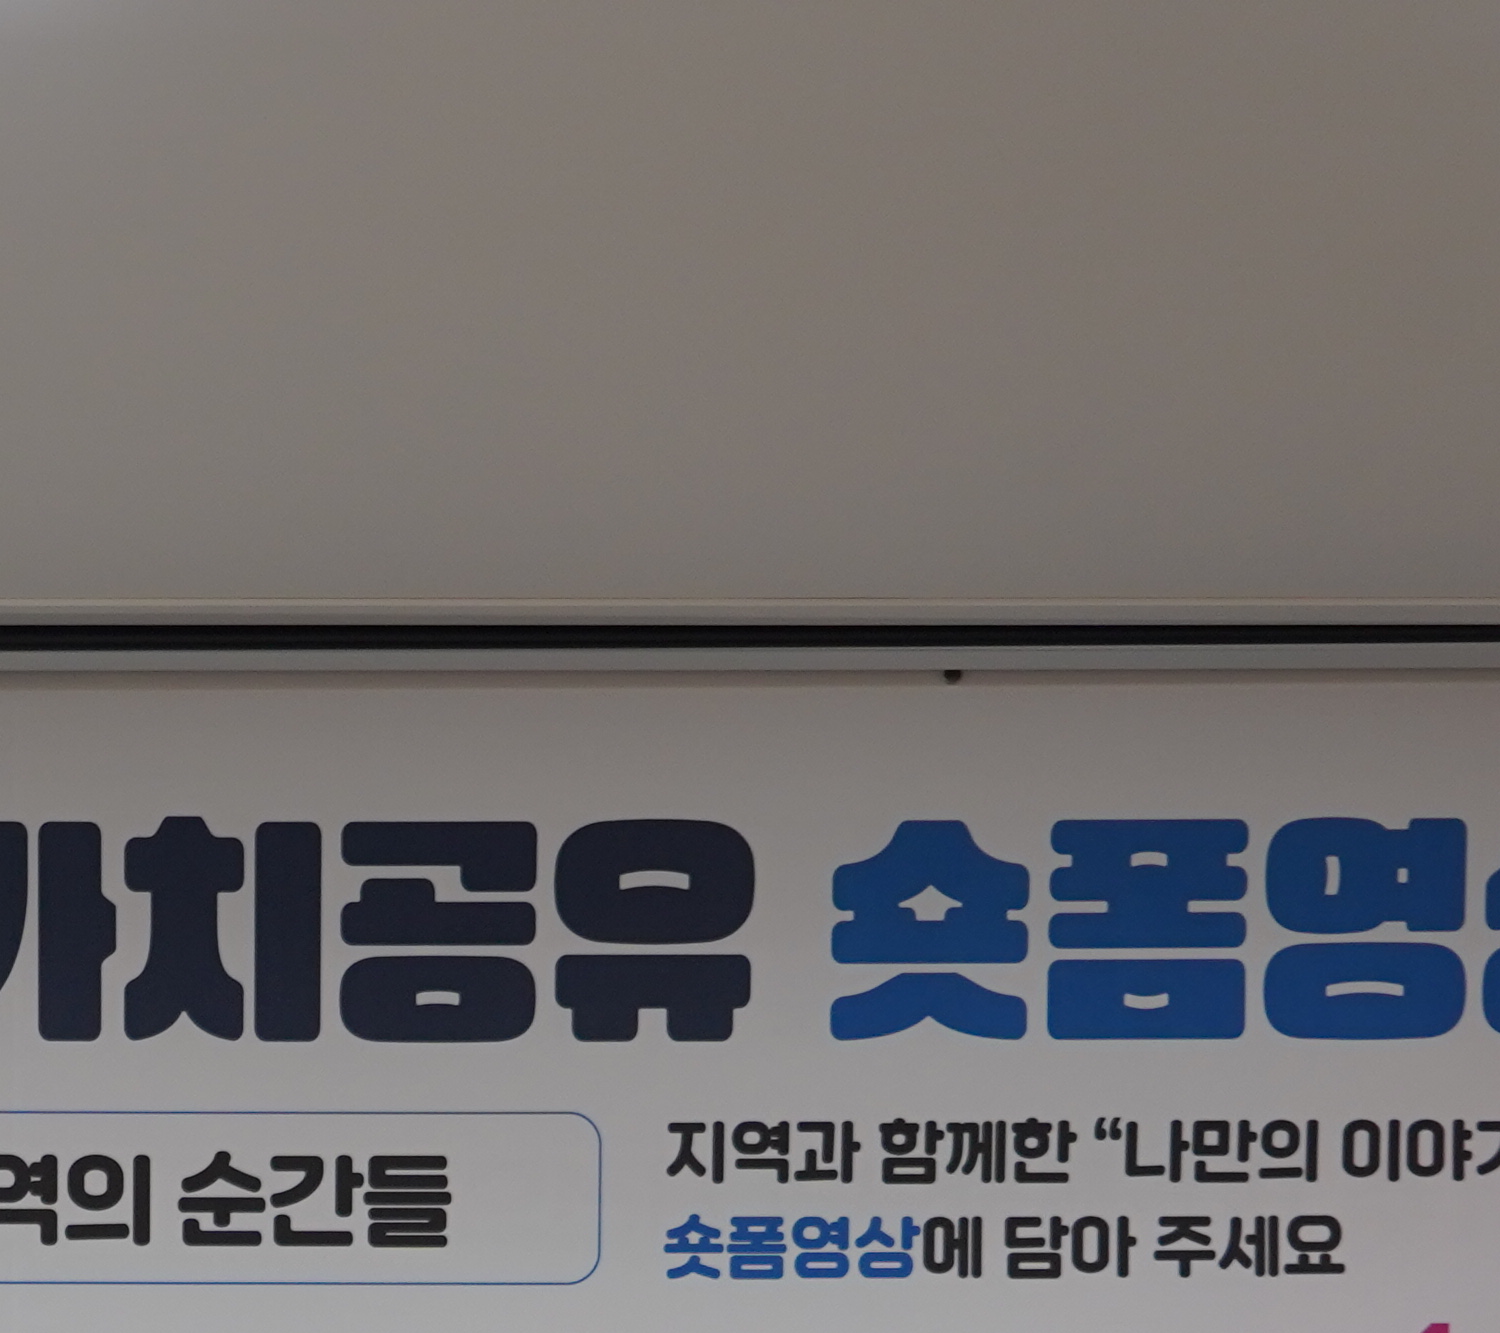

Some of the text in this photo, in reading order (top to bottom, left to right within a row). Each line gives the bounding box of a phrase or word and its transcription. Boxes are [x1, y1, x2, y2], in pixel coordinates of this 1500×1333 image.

[666, 1120, 862, 1185] 지역과
[878, 1117, 1078, 1185] 함께한
[1093, 1116, 1320, 1184] “나만의
[177, 1150, 453, 1249] 순간들
[663, 1213, 1346, 1280] 숏폼영상에 담아 주세요
